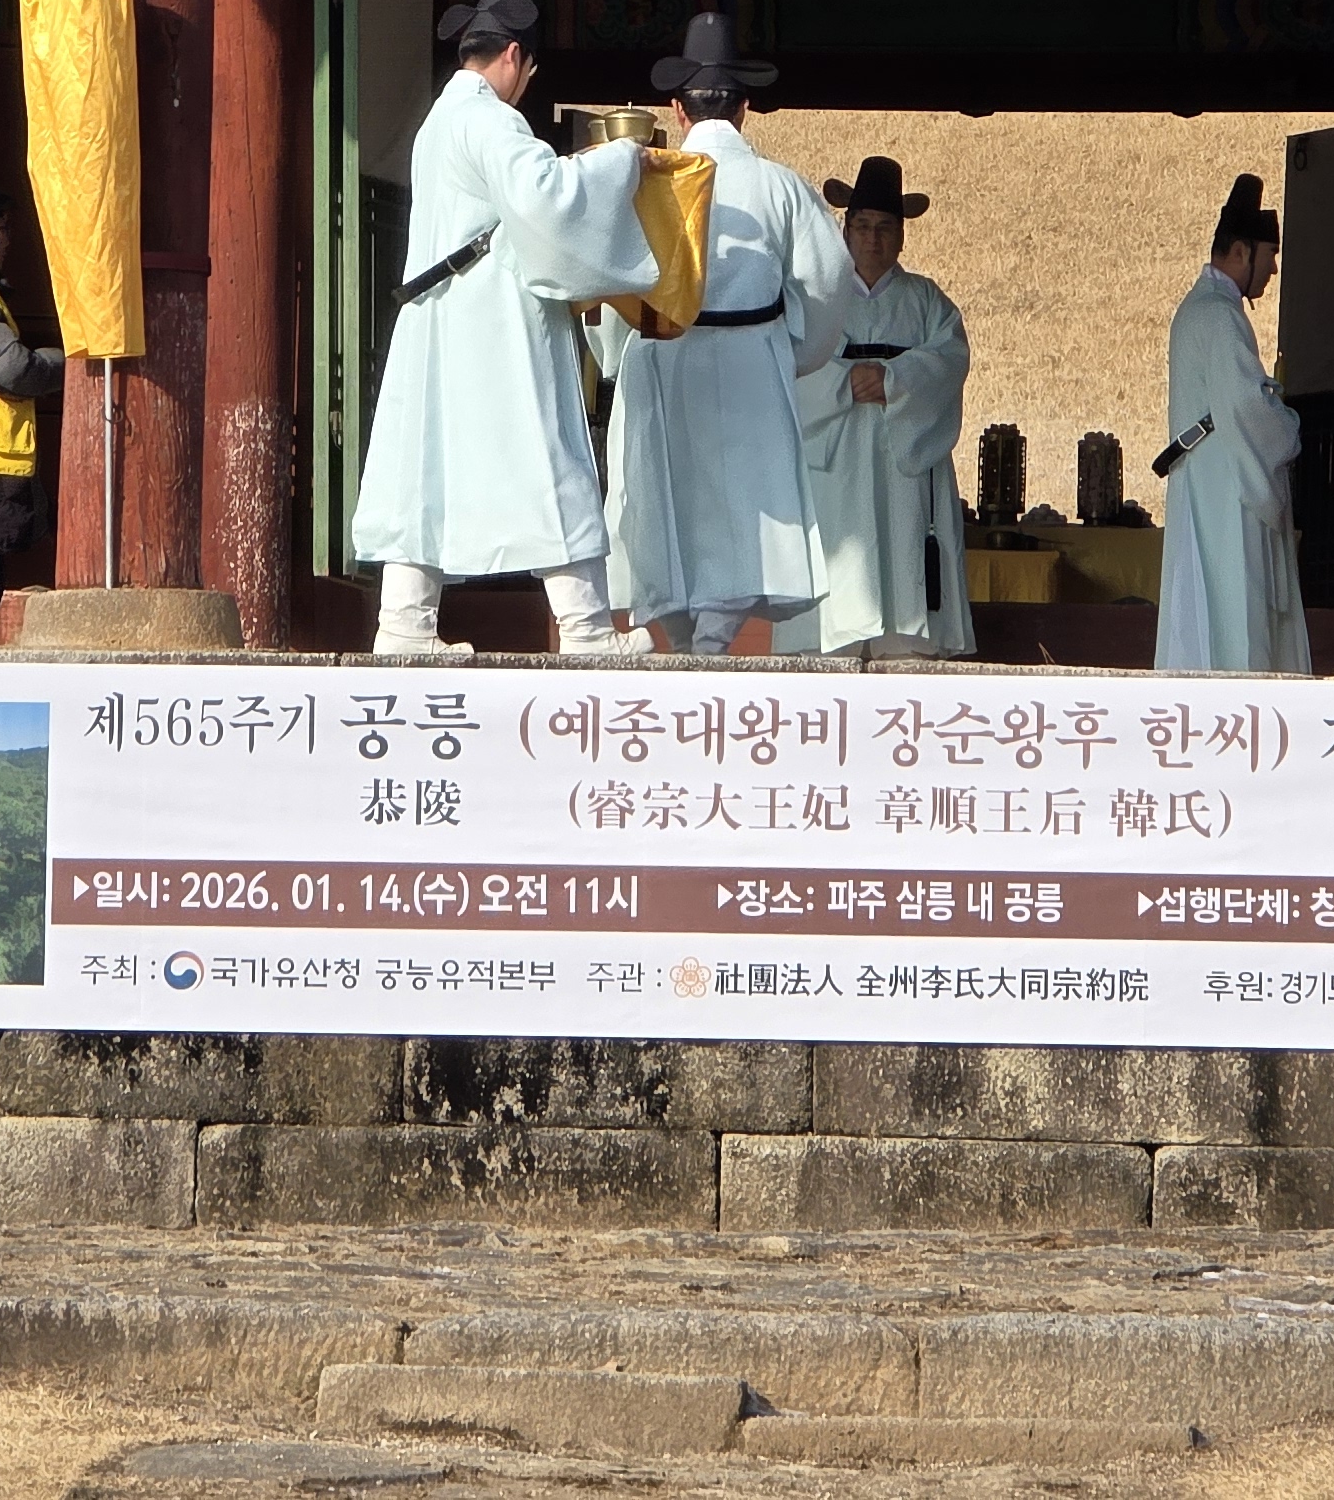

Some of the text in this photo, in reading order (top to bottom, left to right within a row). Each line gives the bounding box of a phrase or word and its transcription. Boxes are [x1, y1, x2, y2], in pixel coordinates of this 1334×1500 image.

[83, 691, 316, 755] 제565주기
[339, 693, 481, 761] 공릉
[519, 694, 848, 767] (예종대왕비
[871, 698, 1118, 771] 장순왕후
[1139, 702, 1289, 773] 한씨)
[359, 777, 462, 827] 恭陵
[568, 779, 851, 832] (睿宗大王妃
[875, 784, 1087, 836] 章順王后
[1109, 787, 1232, 839] 韓氏)
[180, 870, 279, 912] 2026.
[291, 873, 345, 913] 01.
[563, 875, 638, 918] 11시
[827, 879, 887, 920] 파주
[895, 880, 956, 921] 삼릉
[967, 881, 993, 922] 내
[1004, 882, 1064, 923] 공릉
[1155, 886, 1300, 925] 섭행단체:
[210, 956, 361, 990] 국가유산청
[375, 958, 557, 992] 궁능유적본부
[712, 962, 844, 997] 社團法人
[855, 964, 1150, 1003] 全州李氏大同宗約院
